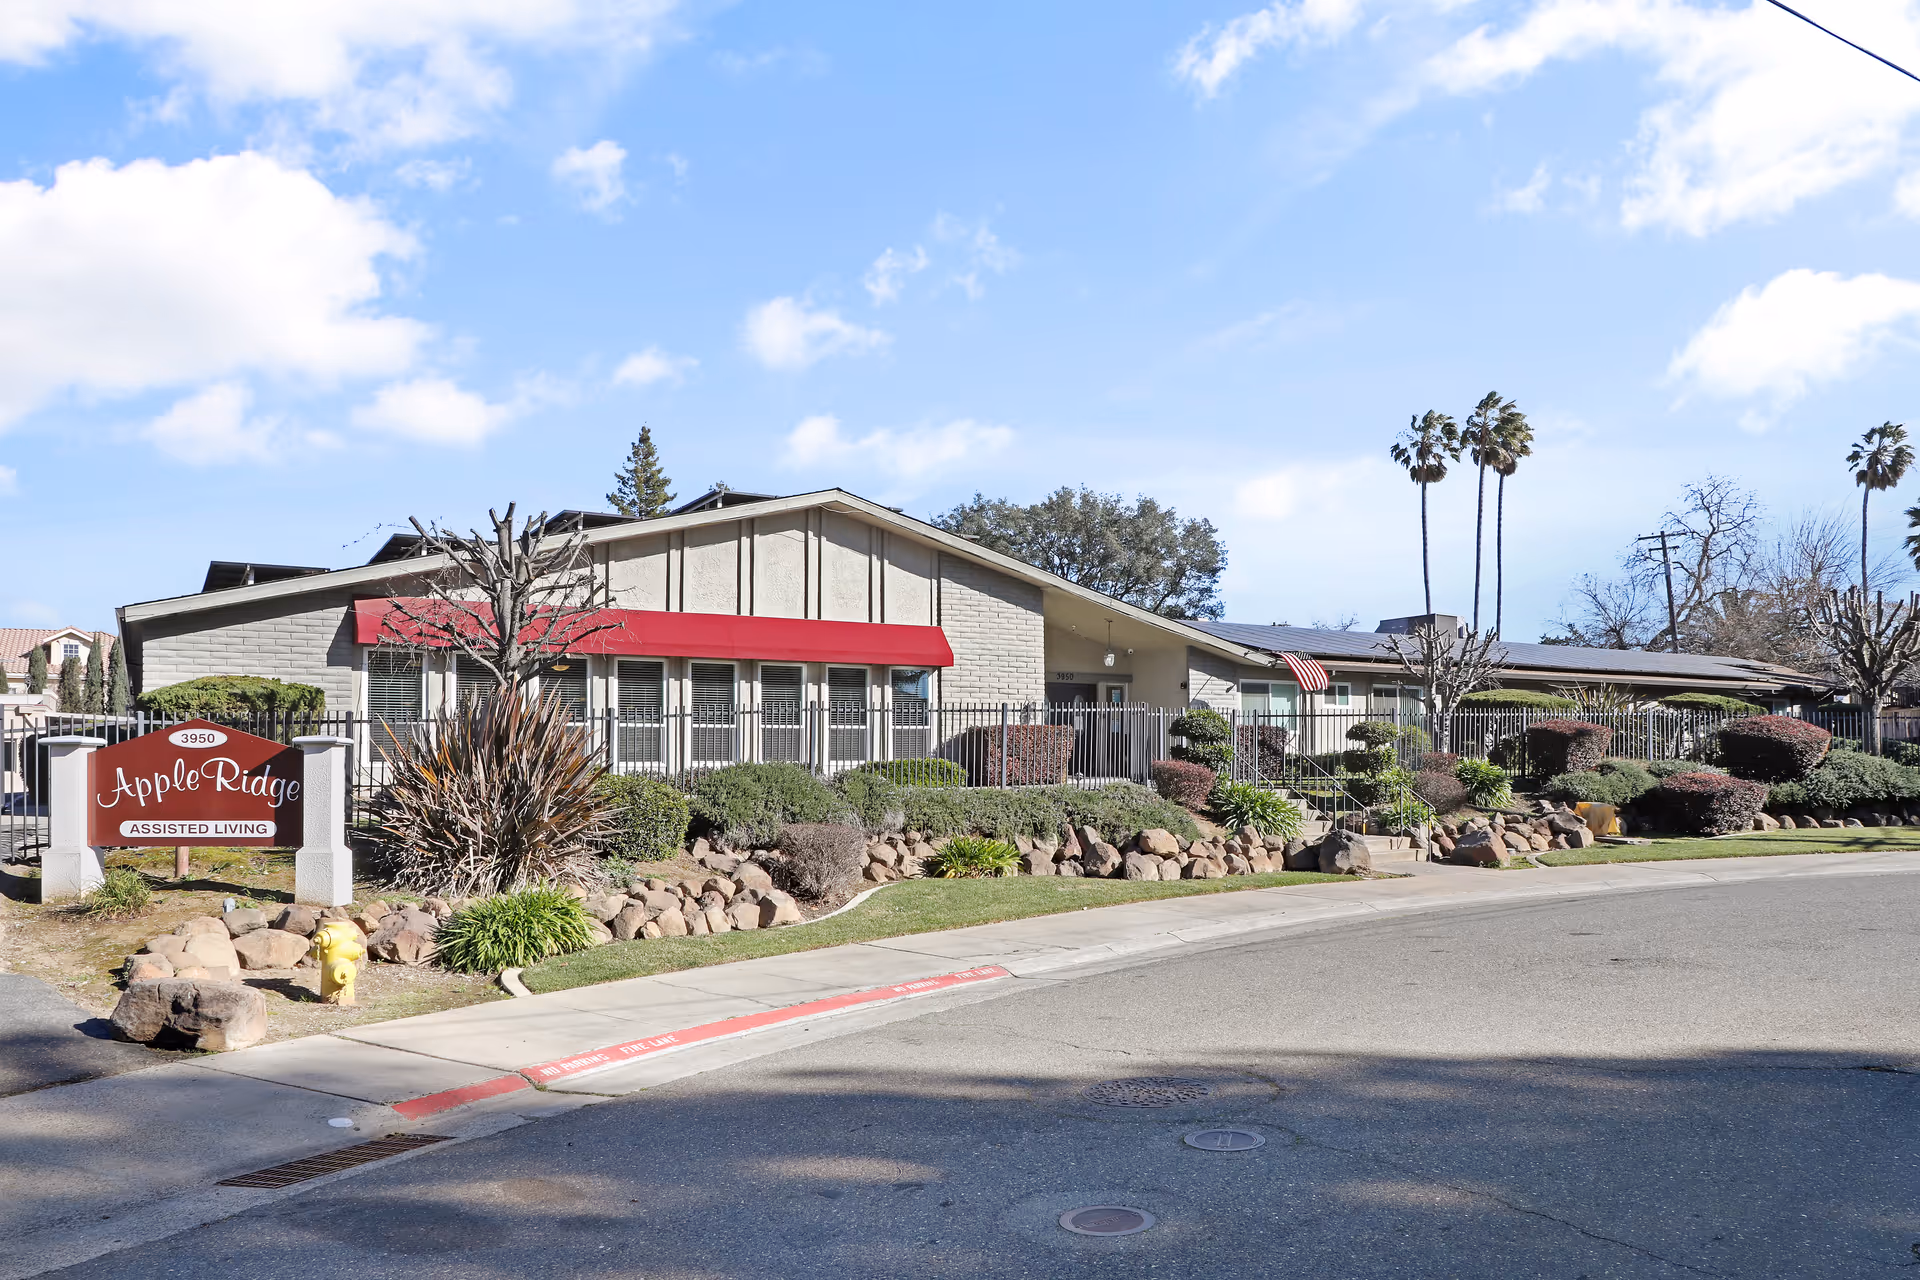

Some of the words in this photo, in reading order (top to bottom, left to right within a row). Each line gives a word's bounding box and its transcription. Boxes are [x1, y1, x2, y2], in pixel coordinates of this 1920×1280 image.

[1056, 672, 1074, 680] 3950
[180, 733, 216, 744] 3950
[97, 758, 200, 808] Apple
[201, 757, 300, 808] Ridge
[129, 823, 209, 834] ASSISTED
[214, 823, 268, 834] LIVING
[539, 1067, 561, 1076] NO
[560, 1053, 610, 1071] PARKING
[619, 1042, 649, 1054] FIRE
[648, 1035, 679, 1047] LANE
